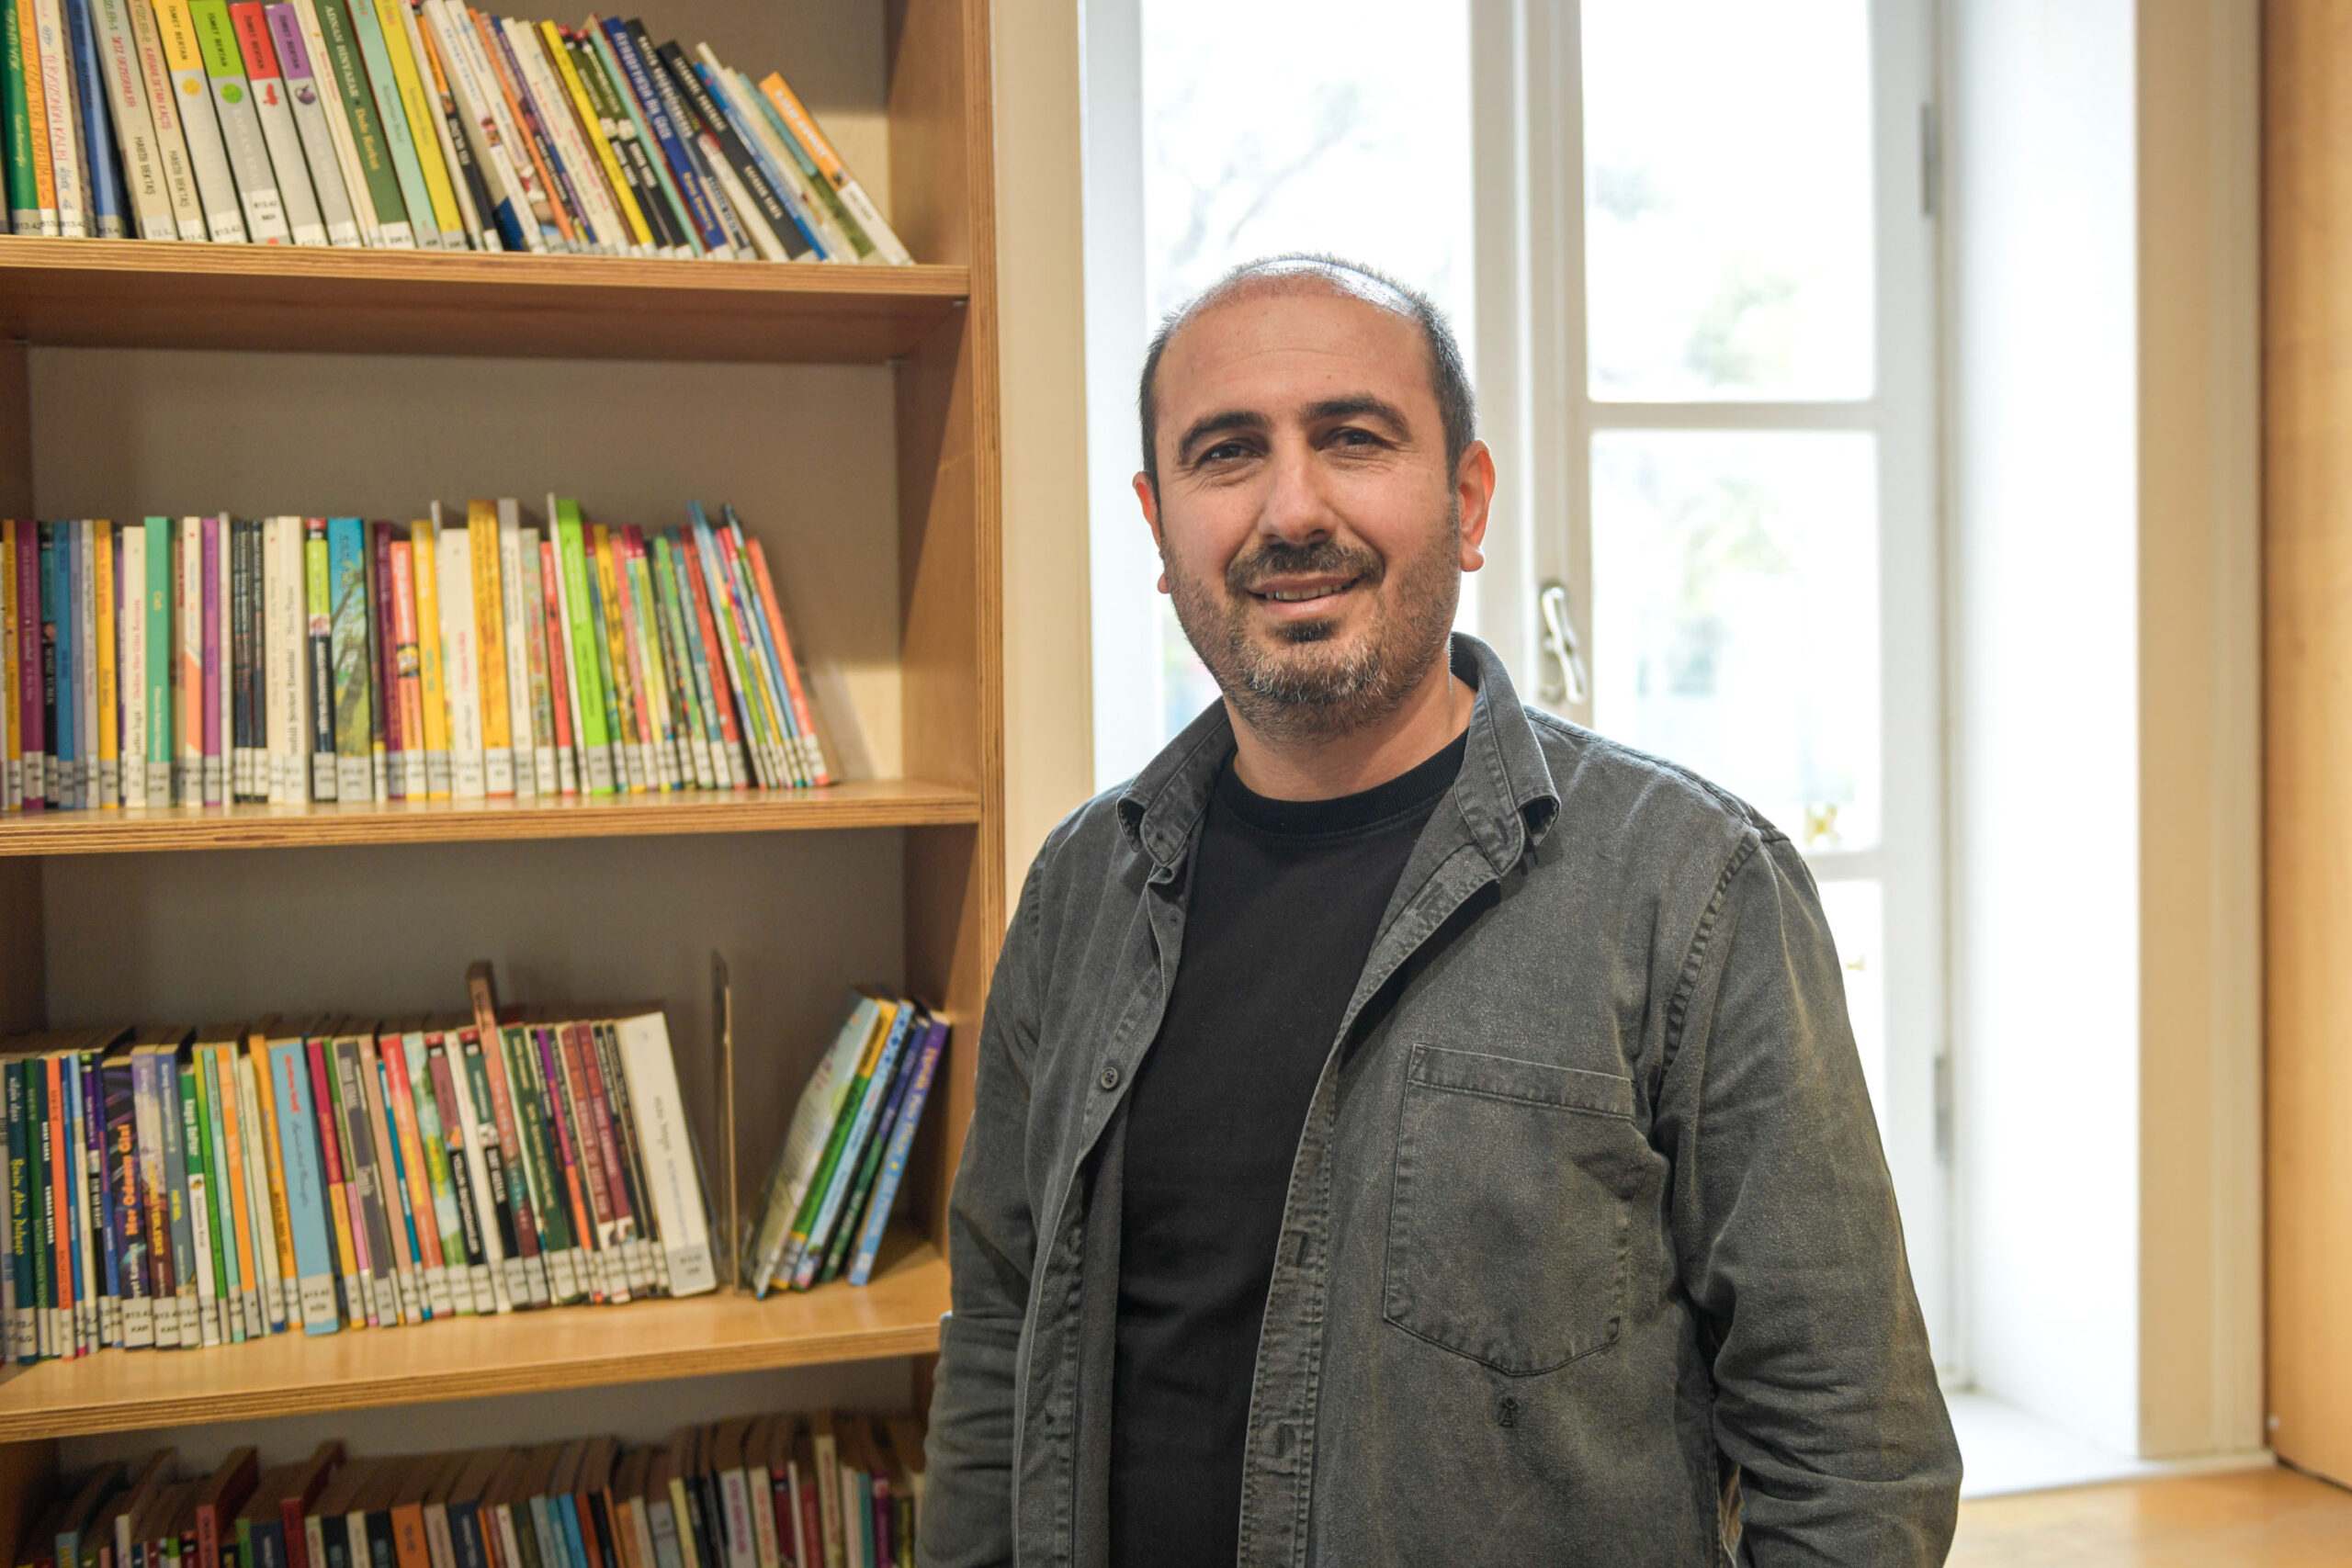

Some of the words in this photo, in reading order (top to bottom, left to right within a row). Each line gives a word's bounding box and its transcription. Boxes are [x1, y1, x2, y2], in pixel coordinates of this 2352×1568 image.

[167, 4, 181, 28] İSMET
[174, 30, 188, 61] BERTAN
[207, 11, 220, 35] İSMET
[213, 37, 228, 67] BERTAN
[251, 39, 266, 70] BERTAN
[277, 13, 292, 39] İSMET
[286, 39, 300, 70] BERTAN
[323, 3, 344, 43] ADNAN
[335, 43, 360, 97] BİNYAZAR
[354, 107, 371, 134] Dede
[361, 133, 381, 171] Korkut
[116, 1123, 132, 1153] Gizi
[119, 1155, 138, 1205] Odanın
[123, 1209, 139, 1235] Mor
